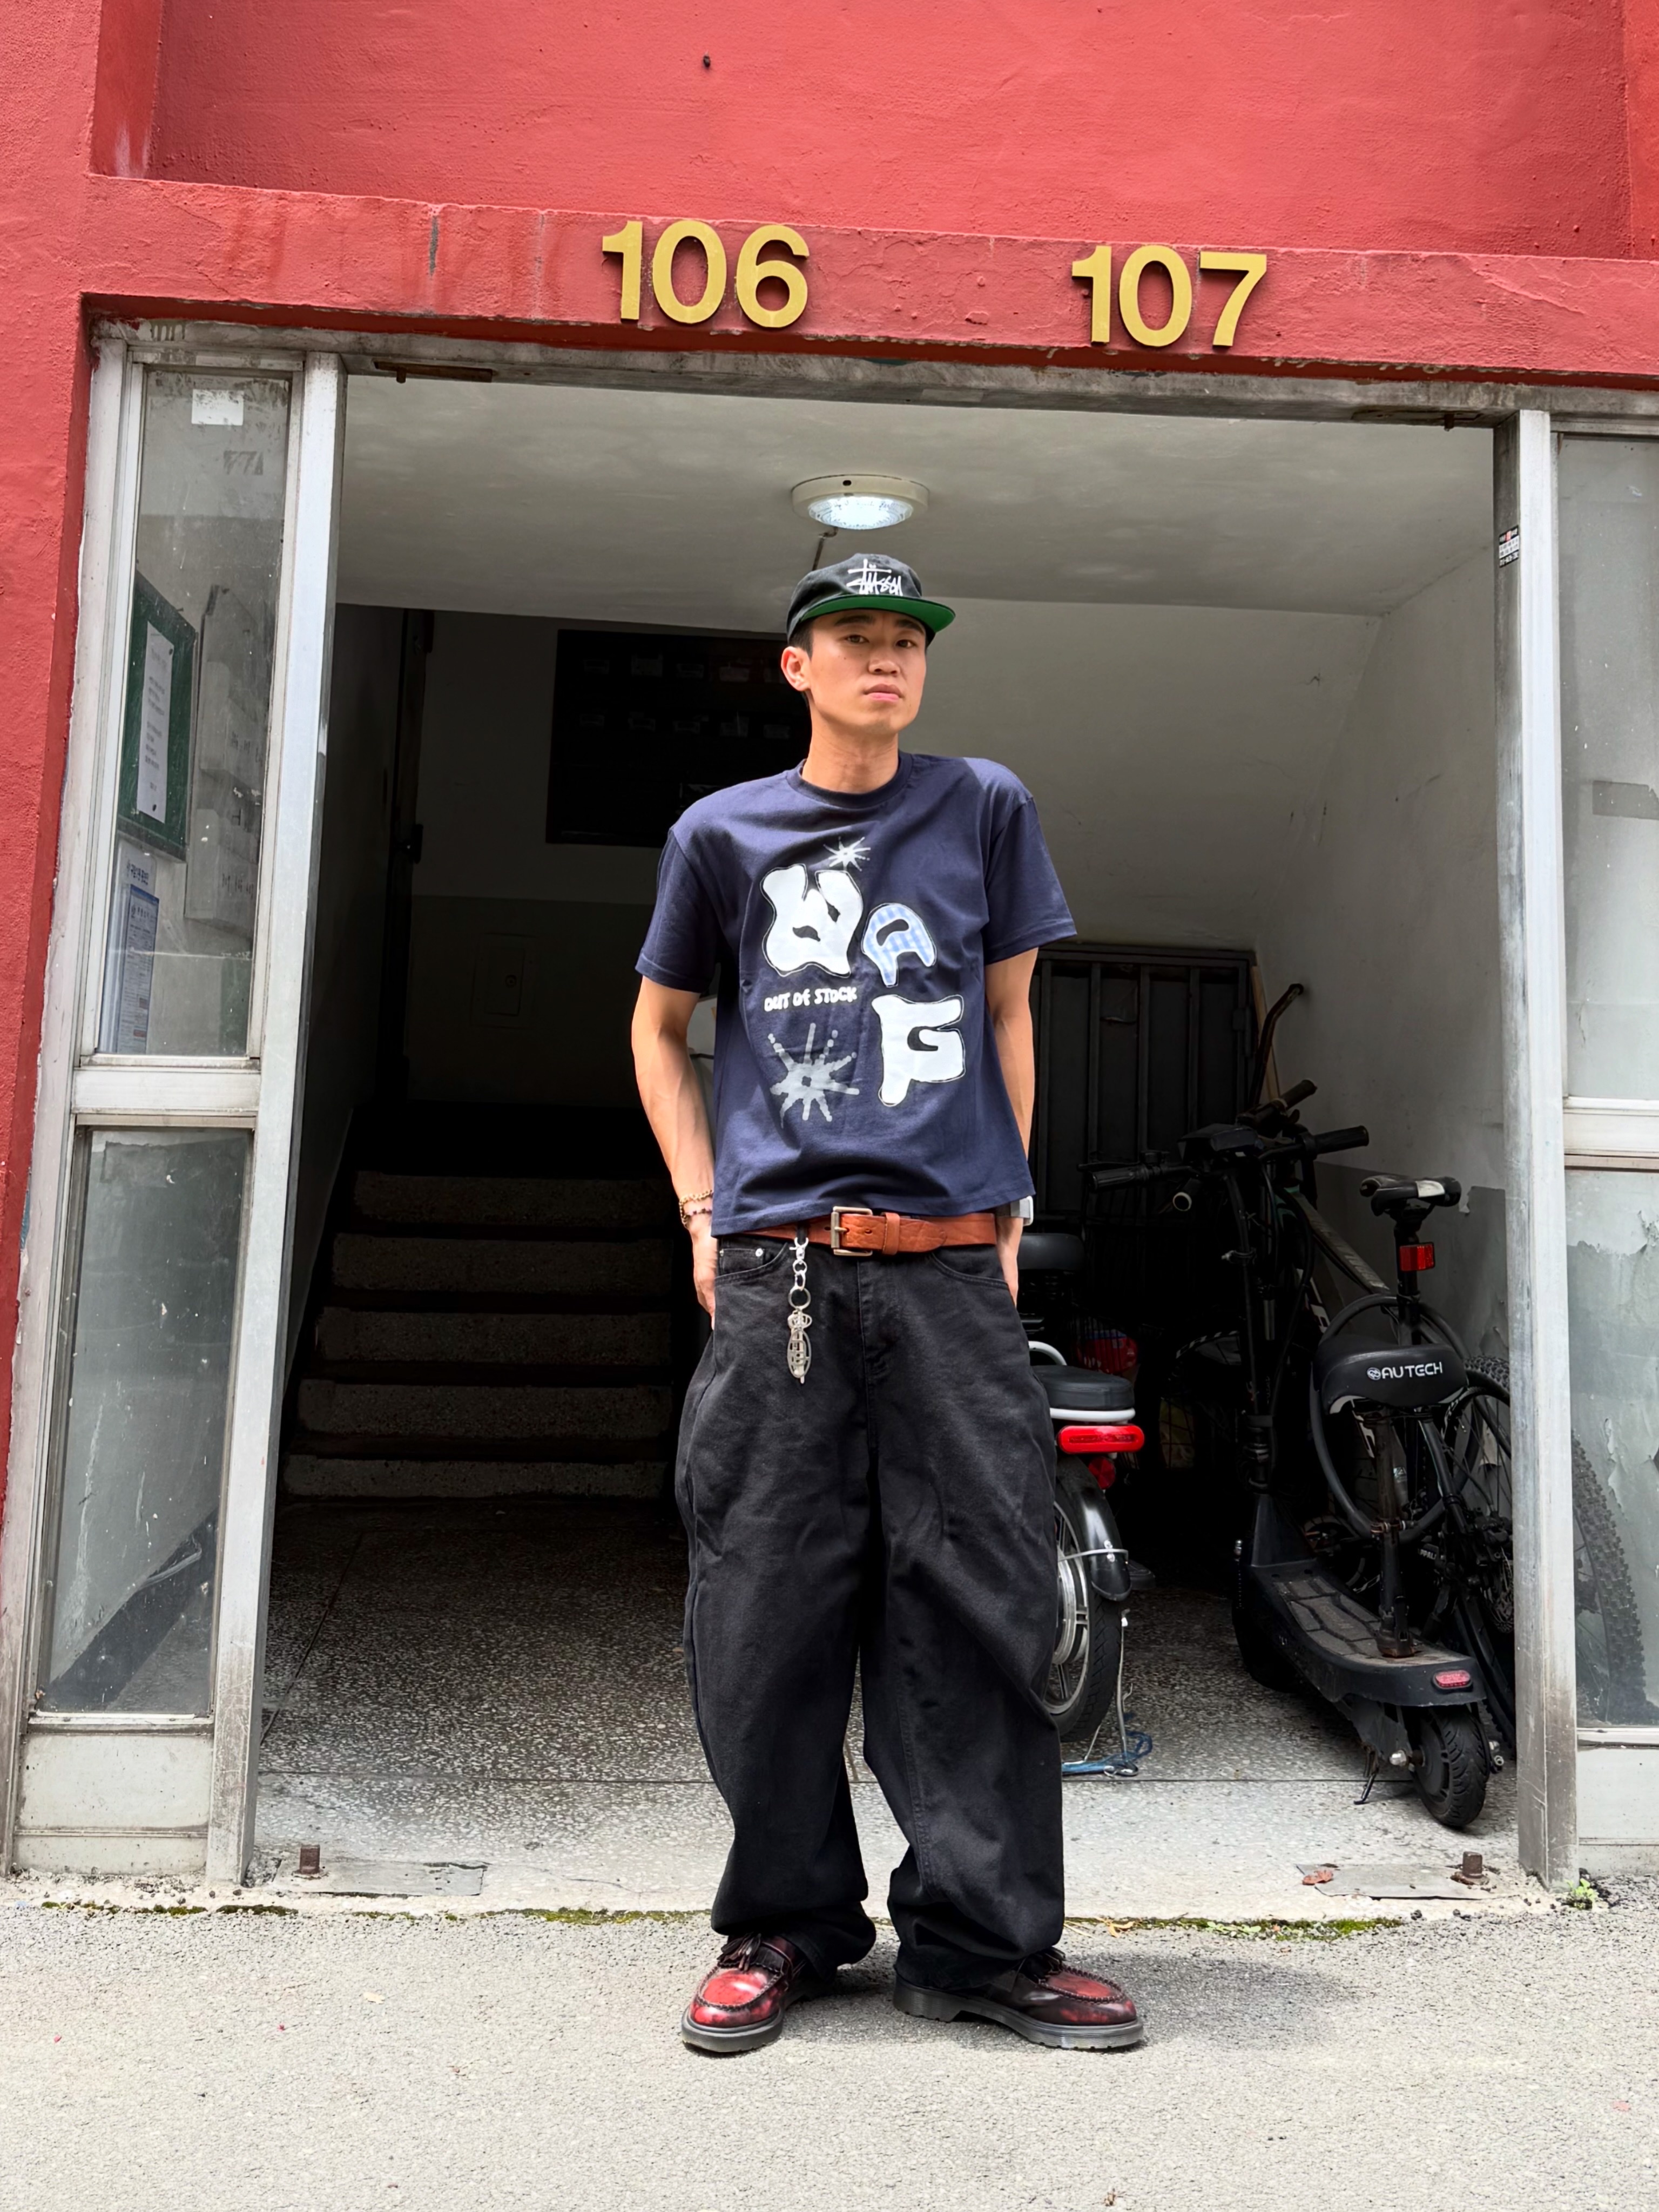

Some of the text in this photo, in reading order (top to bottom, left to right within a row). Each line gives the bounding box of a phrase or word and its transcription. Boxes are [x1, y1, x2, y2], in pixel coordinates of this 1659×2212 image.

[602, 219, 810, 328] 106
[1071, 245, 1267, 347] 107
[764, 992, 791, 1012] OUT
[814, 987, 858, 1004] STOCK
